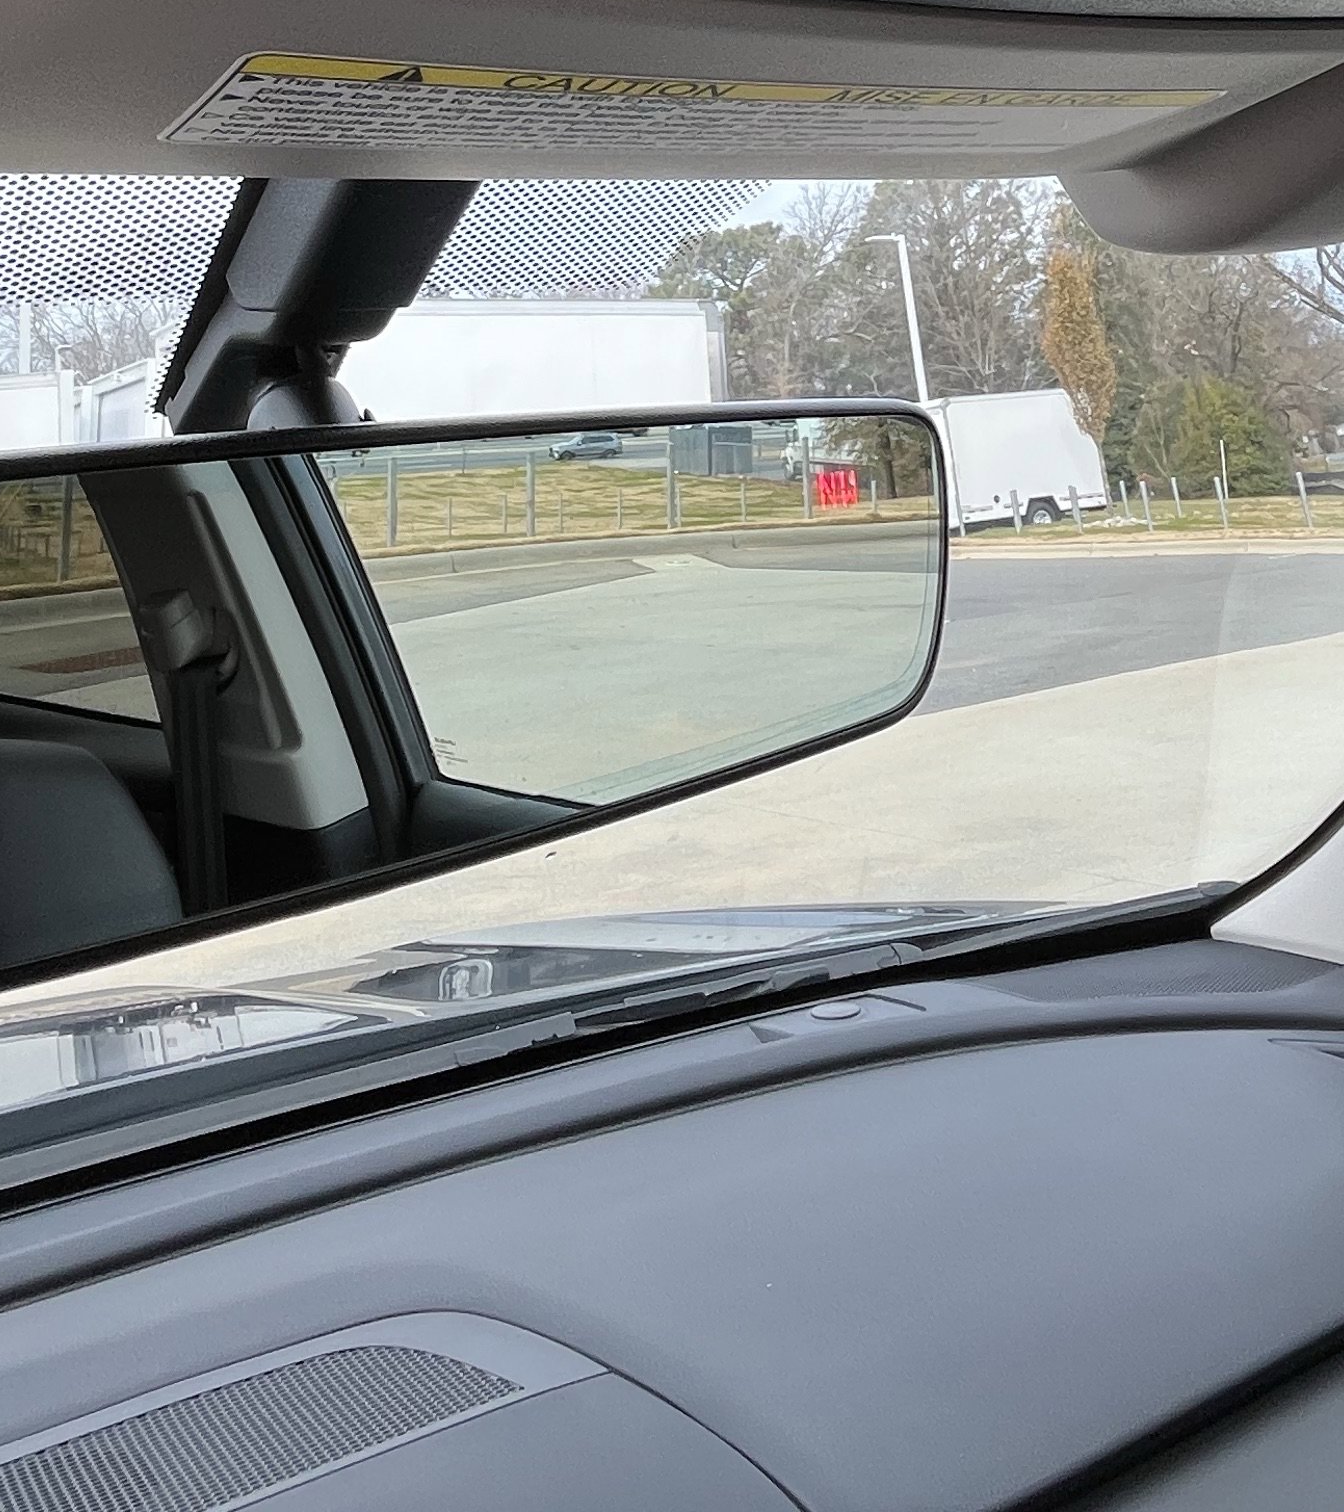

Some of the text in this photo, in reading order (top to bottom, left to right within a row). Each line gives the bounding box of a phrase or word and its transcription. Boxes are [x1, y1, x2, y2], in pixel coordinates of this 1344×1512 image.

[503, 74, 739, 99] CAUTION
[824, 89, 940, 105] MISE
[938, 92, 1008, 106] EN
